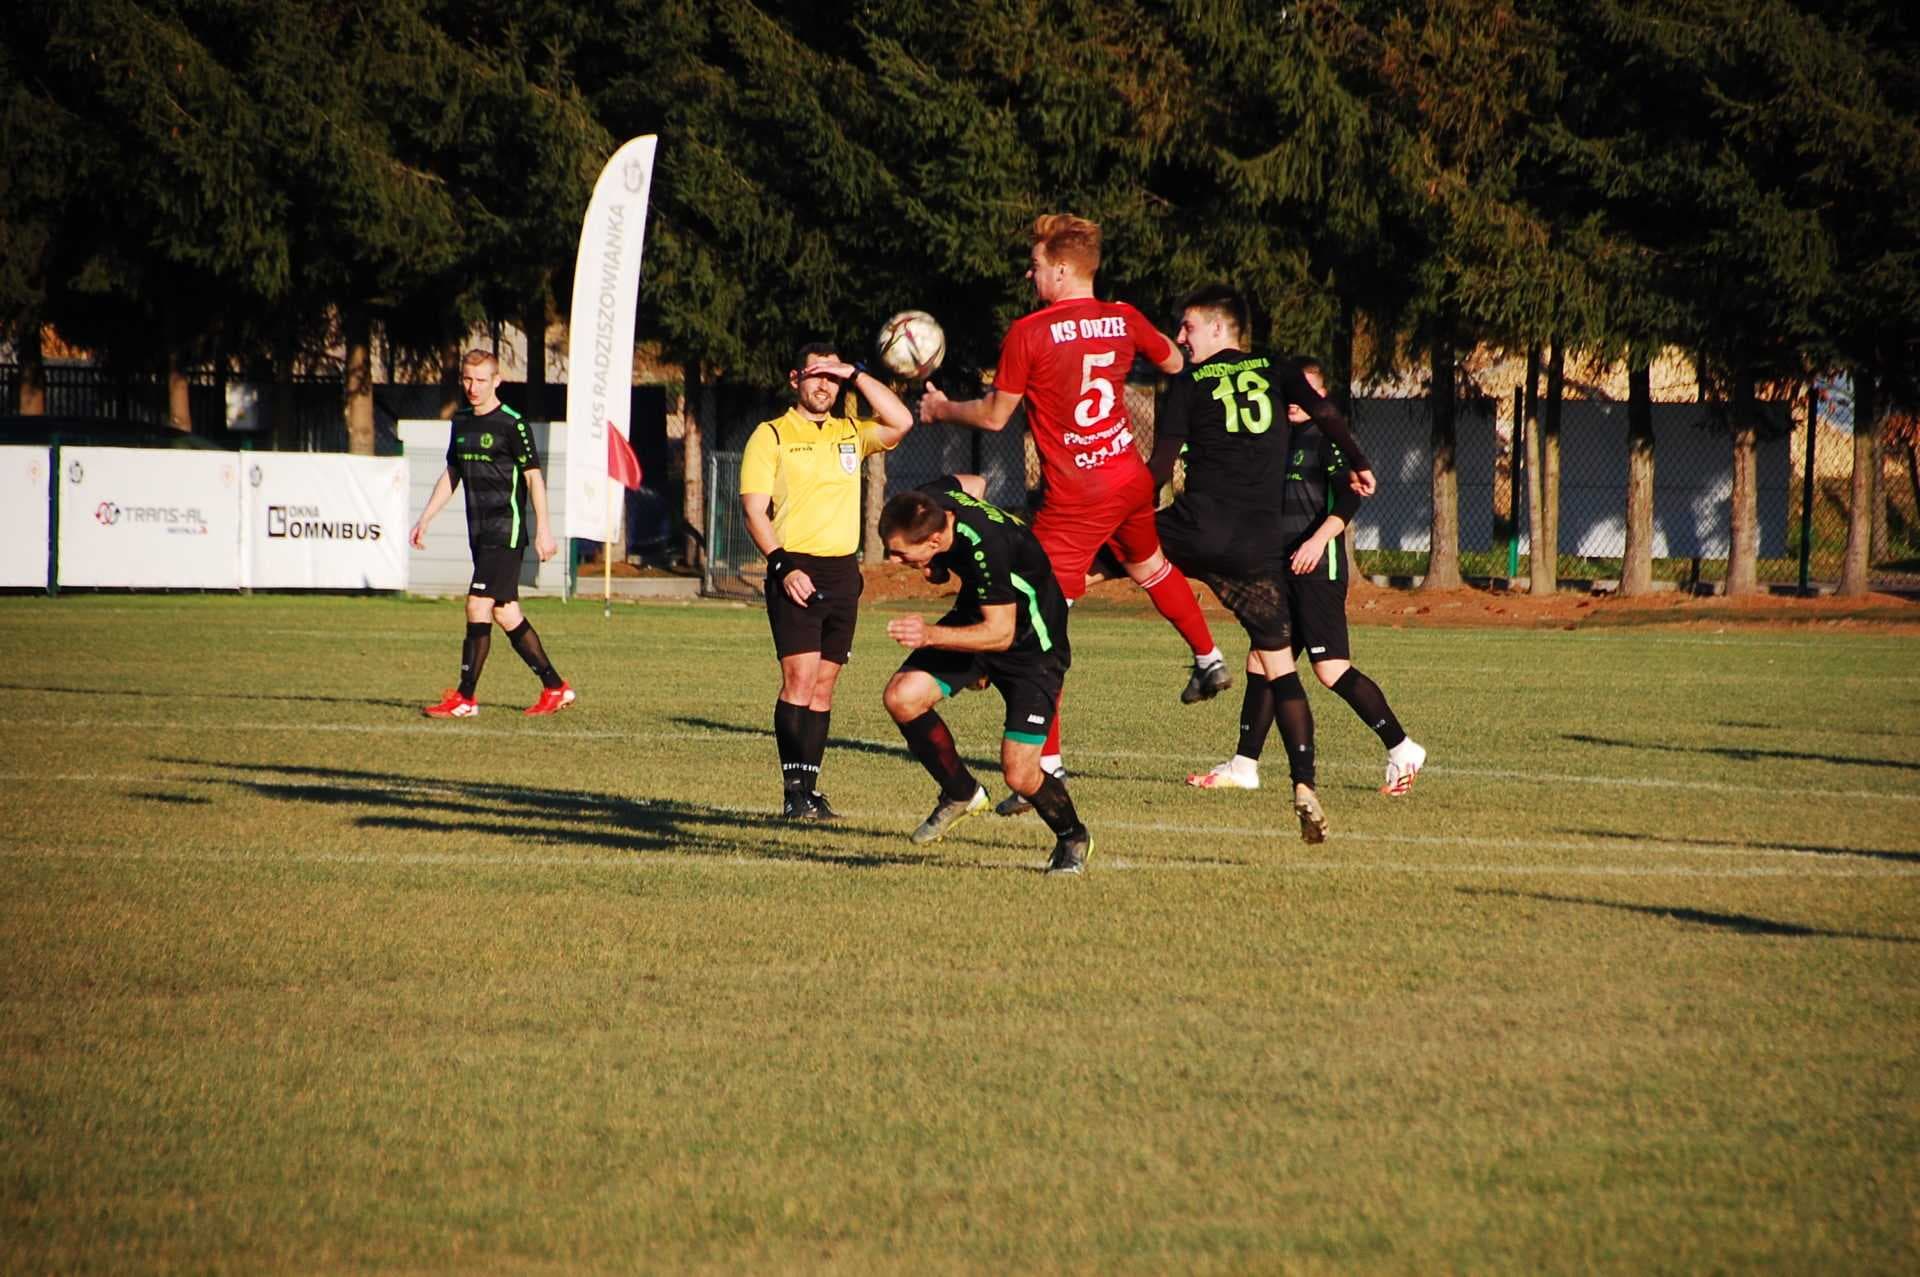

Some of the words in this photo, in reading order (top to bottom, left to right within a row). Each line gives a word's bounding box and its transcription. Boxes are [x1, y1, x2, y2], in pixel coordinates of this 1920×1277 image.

[593, 205, 625, 398] RADZISZOWIANKA
[1050, 320, 1078, 344] KS
[1074, 351, 1116, 428] 5
[1212, 371, 1272, 434] 13
[591, 400, 605, 440] LKS
[124, 506, 208, 524] TRANS-AL
[289, 505, 320, 518] OKNA
[289, 521, 381, 540] OMNIBUS
